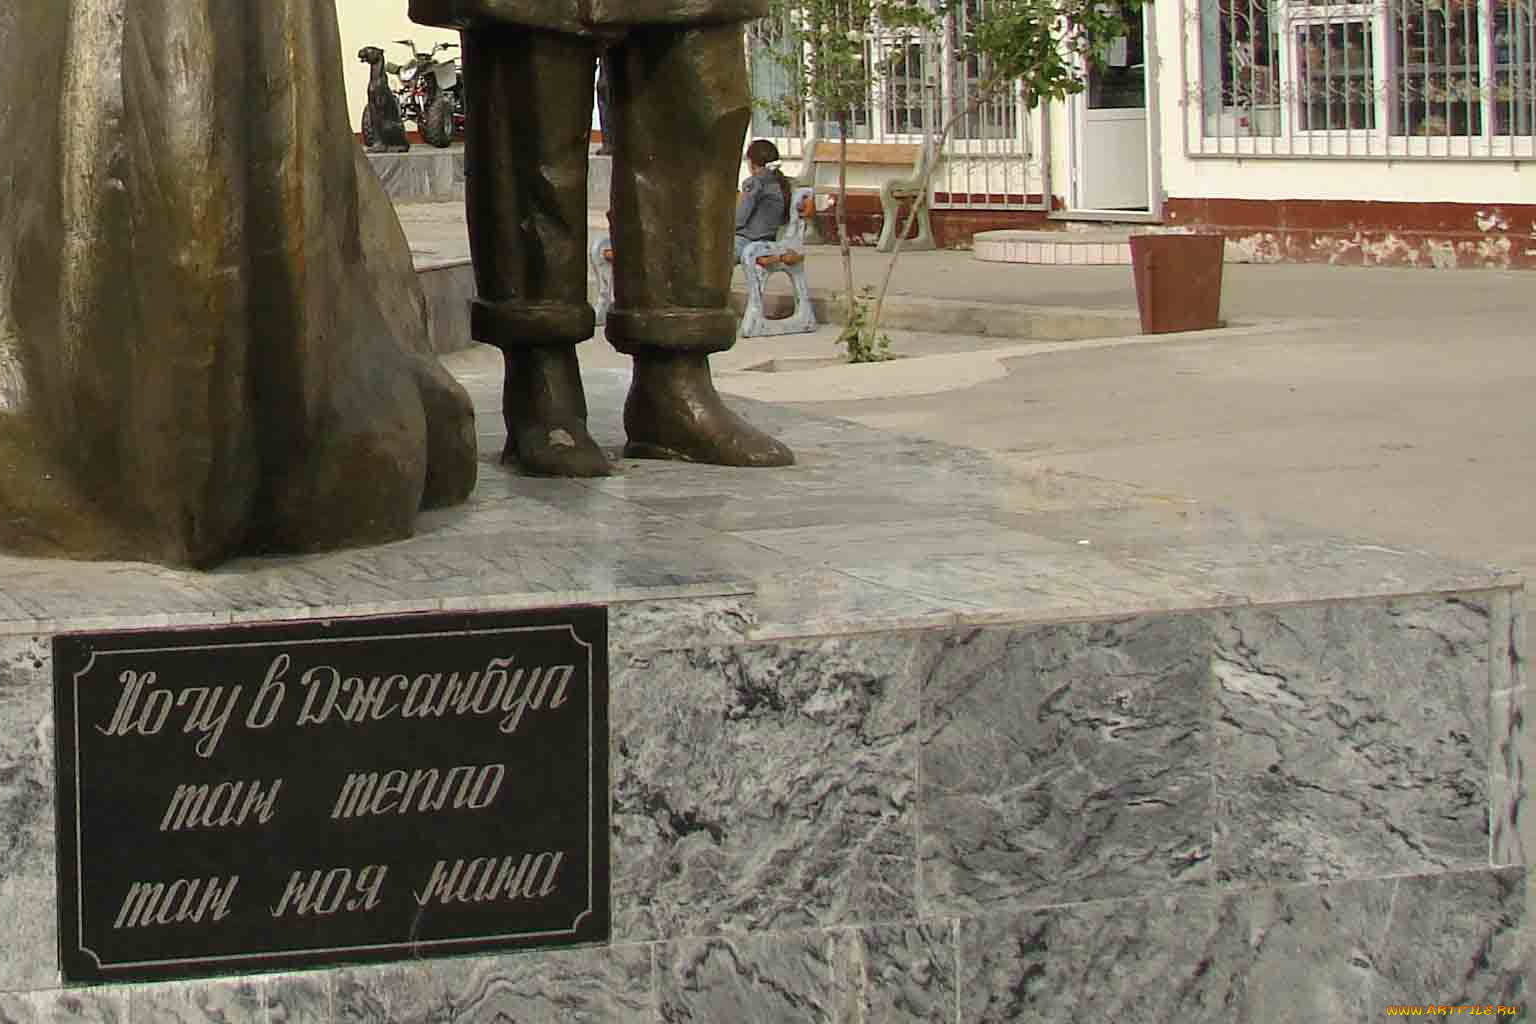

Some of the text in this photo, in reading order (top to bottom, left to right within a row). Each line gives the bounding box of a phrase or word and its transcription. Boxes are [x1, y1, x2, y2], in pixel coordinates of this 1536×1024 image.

[96, 653, 576, 759] Хочу в Джамбул
[160, 763, 506, 832] там тепло
[113, 850, 563, 929] там моя мама
